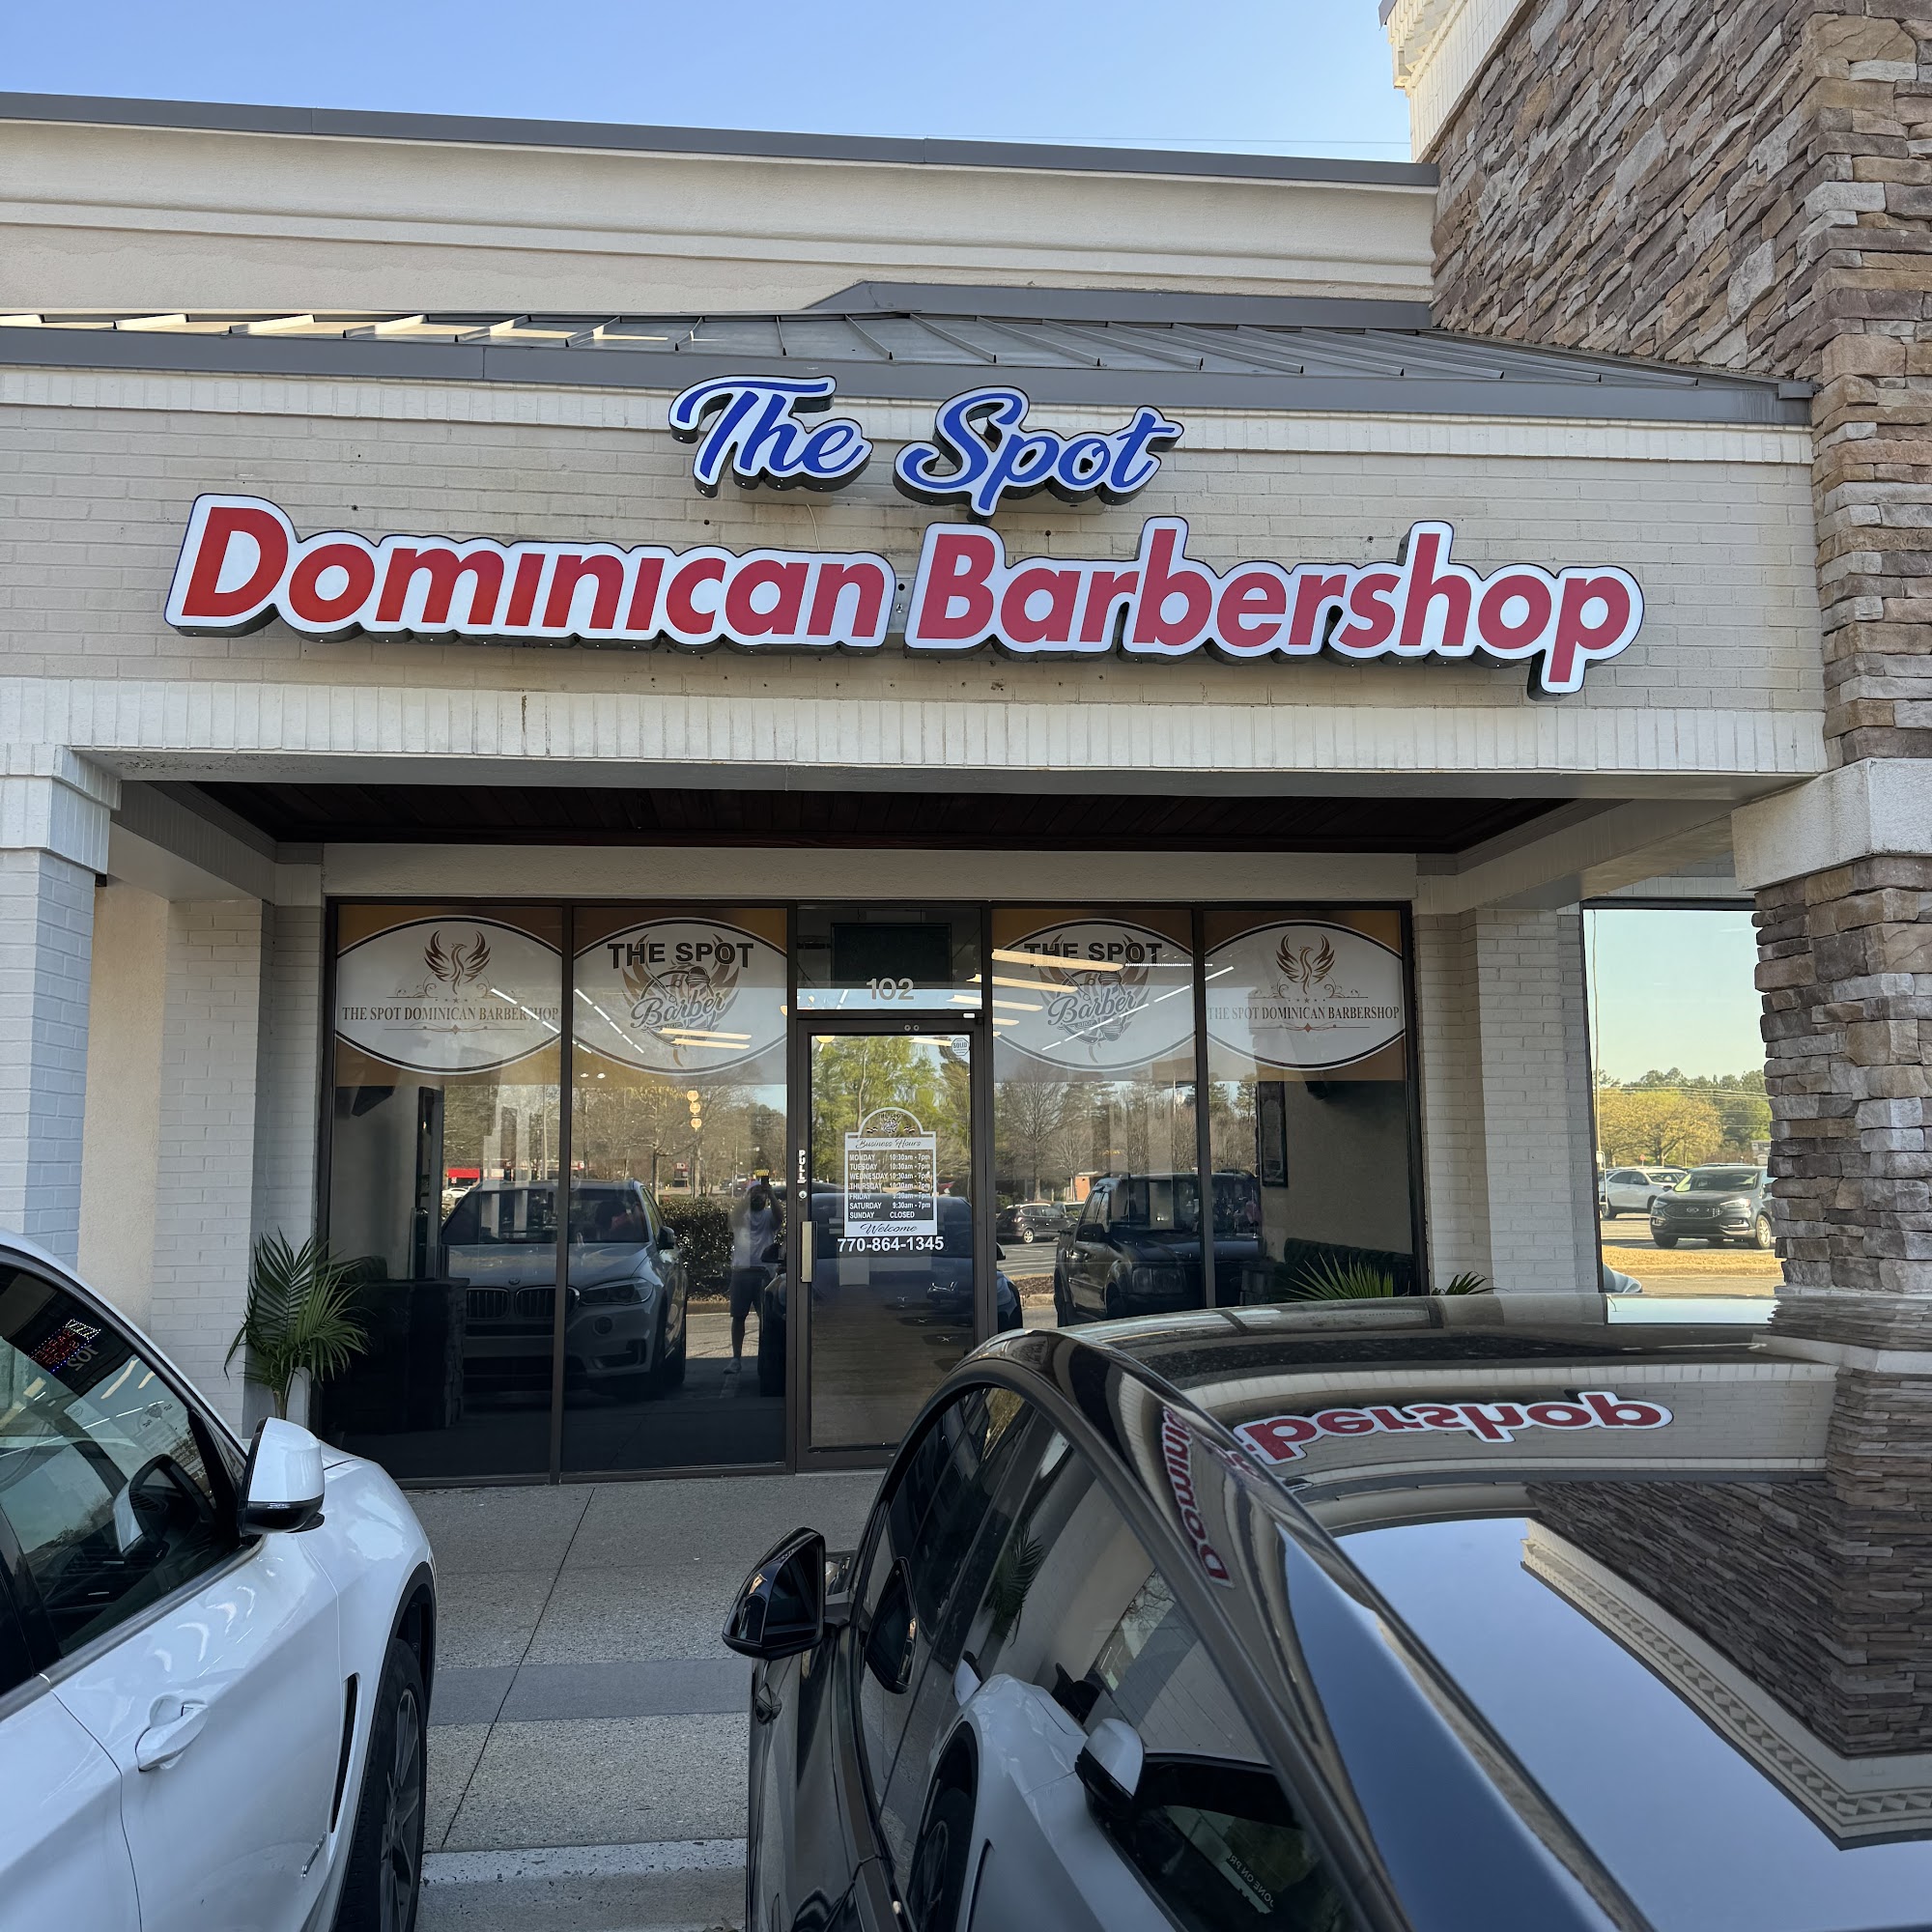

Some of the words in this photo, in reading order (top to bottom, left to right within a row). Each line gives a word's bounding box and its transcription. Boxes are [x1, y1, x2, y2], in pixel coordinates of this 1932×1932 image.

[675, 380, 866, 480] The
[901, 391, 1177, 512] Spot
[180, 504, 886, 639] Dominican
[916, 527, 1633, 685] Barbershop
[607, 943, 666, 969] THE
[675, 942, 754, 968] SPOT
[1088, 942, 1163, 966] SPOT
[866, 978, 914, 1001] 102
[630, 990, 725, 1028] Barber
[1047, 985, 1137, 1025] Barber
[1208, 1007, 1230, 1020] THE
[1232, 1007, 1260, 1020] SPOT
[1263, 1006, 1326, 1020] DOMINICAN
[1328, 1006, 1400, 1020] BARBERSHOP
[342, 1007, 366, 1020] THE
[370, 1007, 402, 1021] SPOT
[405, 1007, 476, 1020] DOMINICAN
[479, 1007, 559, 1021] BARBERSHOP
[855, 1138, 893, 1150] Business
[895, 1138, 922, 1150] Hours
[798, 1149, 807, 1180] PULL
[918, 1153, 931, 1162] 7pm
[918, 1162, 931, 1171] 7pm
[849, 1172, 889, 1180] WEDNESDAY
[918, 1201, 931, 1209] 7pm
[860, 1222, 918, 1235] Welcome
[837, 1236, 945, 1253] 770-864-1345
